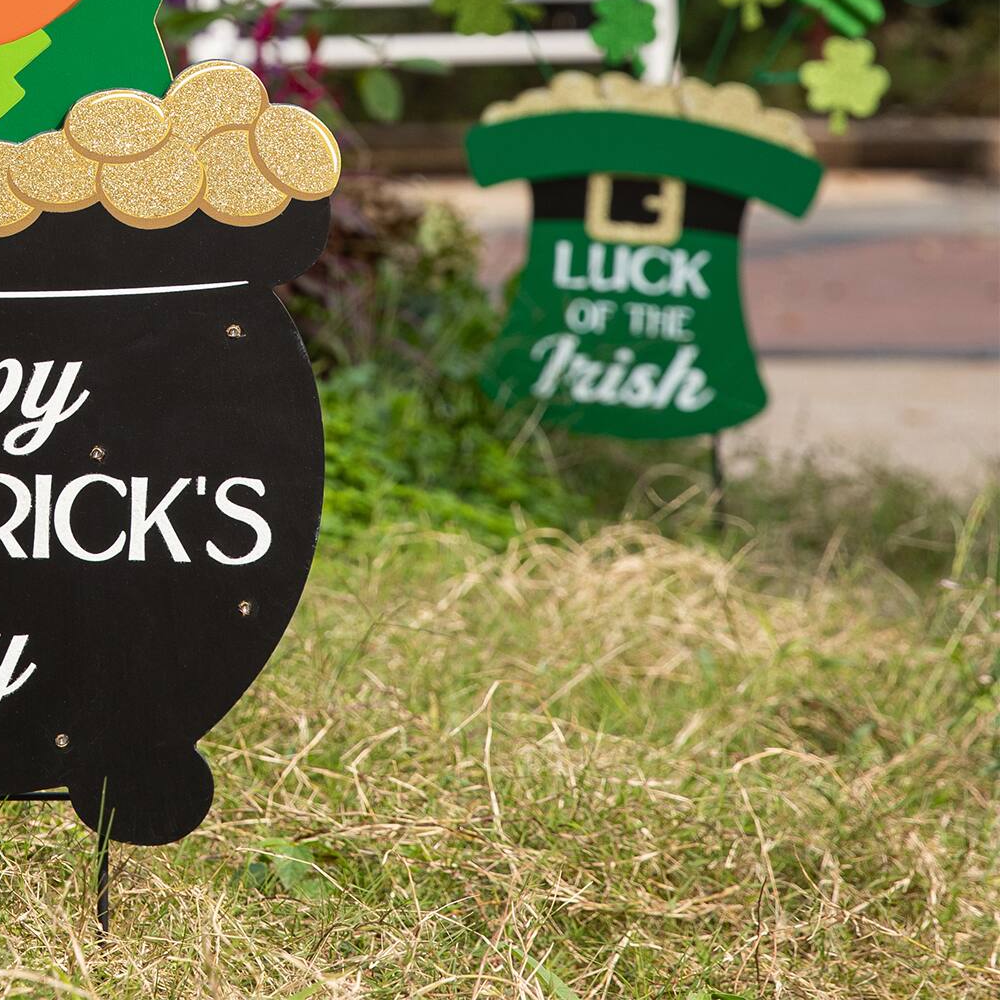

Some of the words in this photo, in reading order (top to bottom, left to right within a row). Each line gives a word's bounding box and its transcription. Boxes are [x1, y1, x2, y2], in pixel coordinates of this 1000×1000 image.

[552, 239, 713, 299] LUCK
[564, 298, 615, 335] OF
[624, 302, 695, 341] THE
[530, 333, 715, 413] Irish
